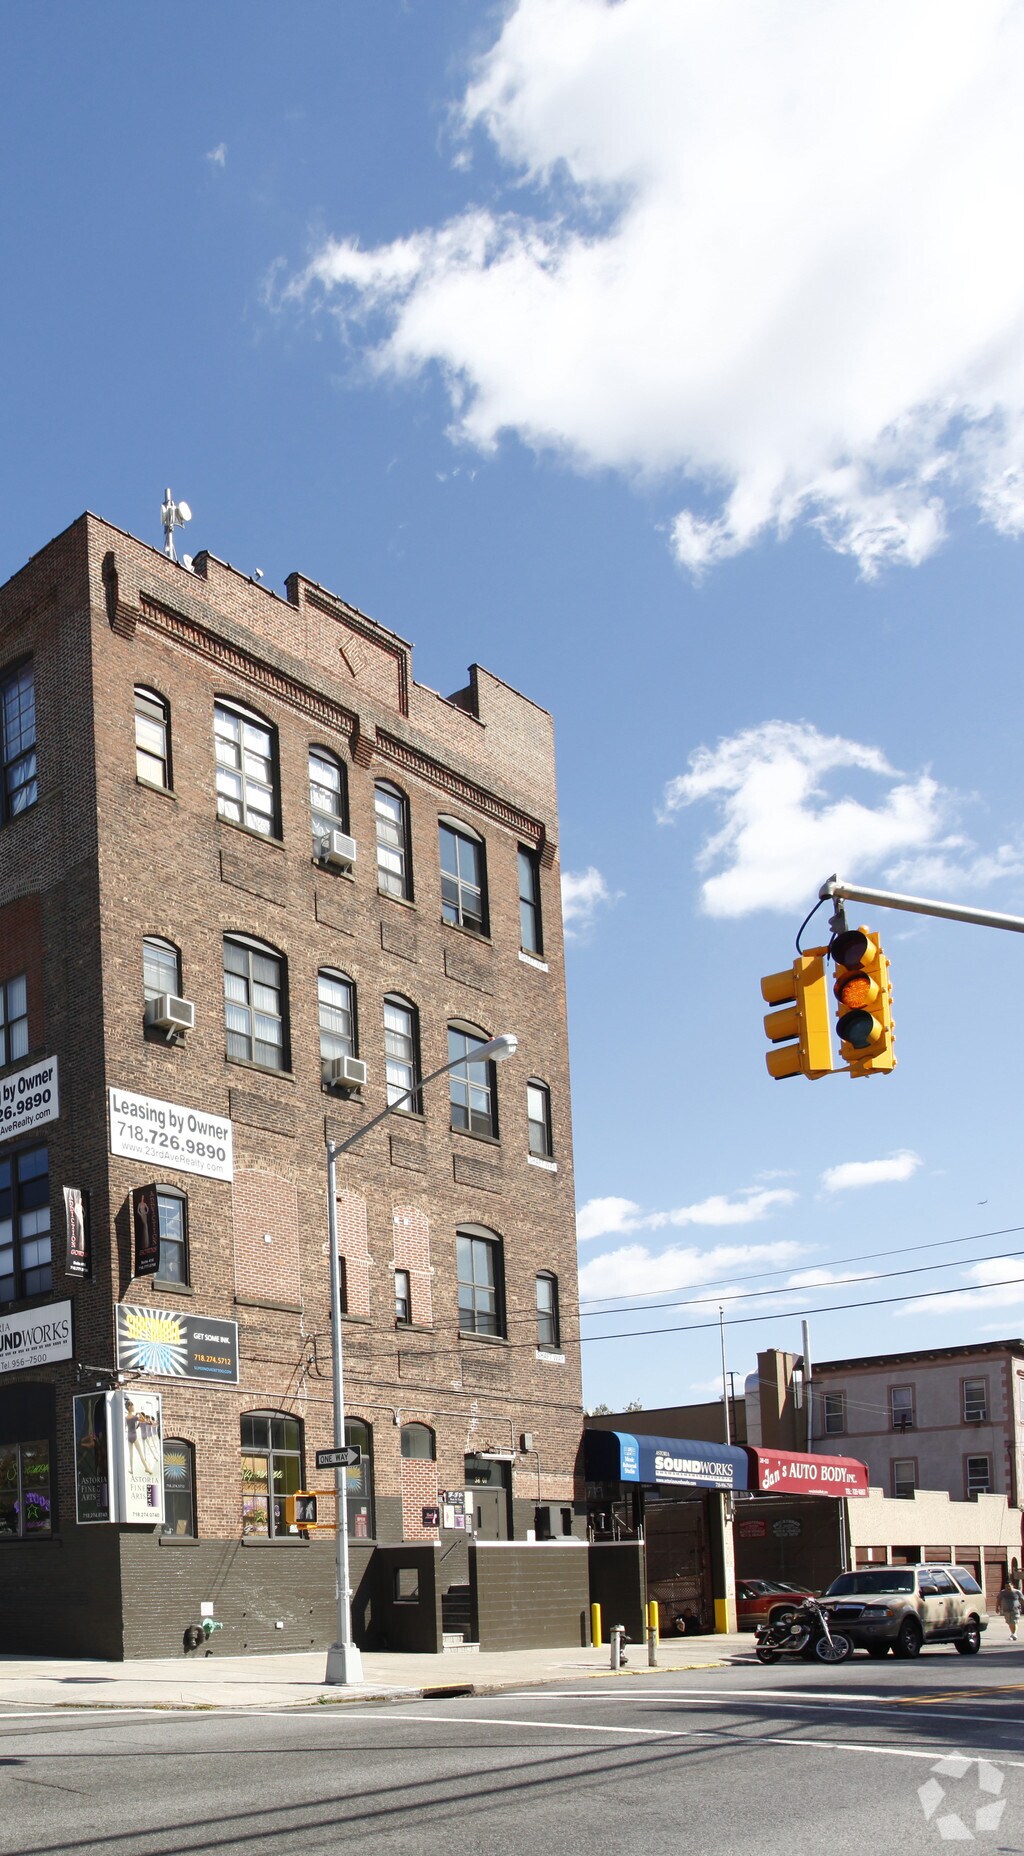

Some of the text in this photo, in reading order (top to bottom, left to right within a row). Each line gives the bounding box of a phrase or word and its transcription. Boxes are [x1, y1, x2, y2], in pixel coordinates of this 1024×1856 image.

[3, 1085, 16, 1103] by
[18, 1068, 53, 1094] Owner
[113, 1094, 228, 1141] Leasing by Owner
[117, 1121, 226, 1162] 718.726.9890
[121, 1142, 224, 1173] www.23rdAveRealty.com
[204, 1334, 219, 1342] SOME
[11, 1354, 47, 1367] 956-7500
[194, 1354, 231, 1365] 718.274.5712
[320, 1453, 348, 1464] ONE WAY
[655, 1456, 733, 1476] SOUNDWORKS
[81, 1476, 107, 1484] ASTORIA
[130, 1475, 159, 1483] ASTORIA
[762, 1461, 858, 1489] Jan's AUTO BODY INC.
[81, 1485, 96, 1493] FINE
[81, 1493, 97, 1501] ARTS
